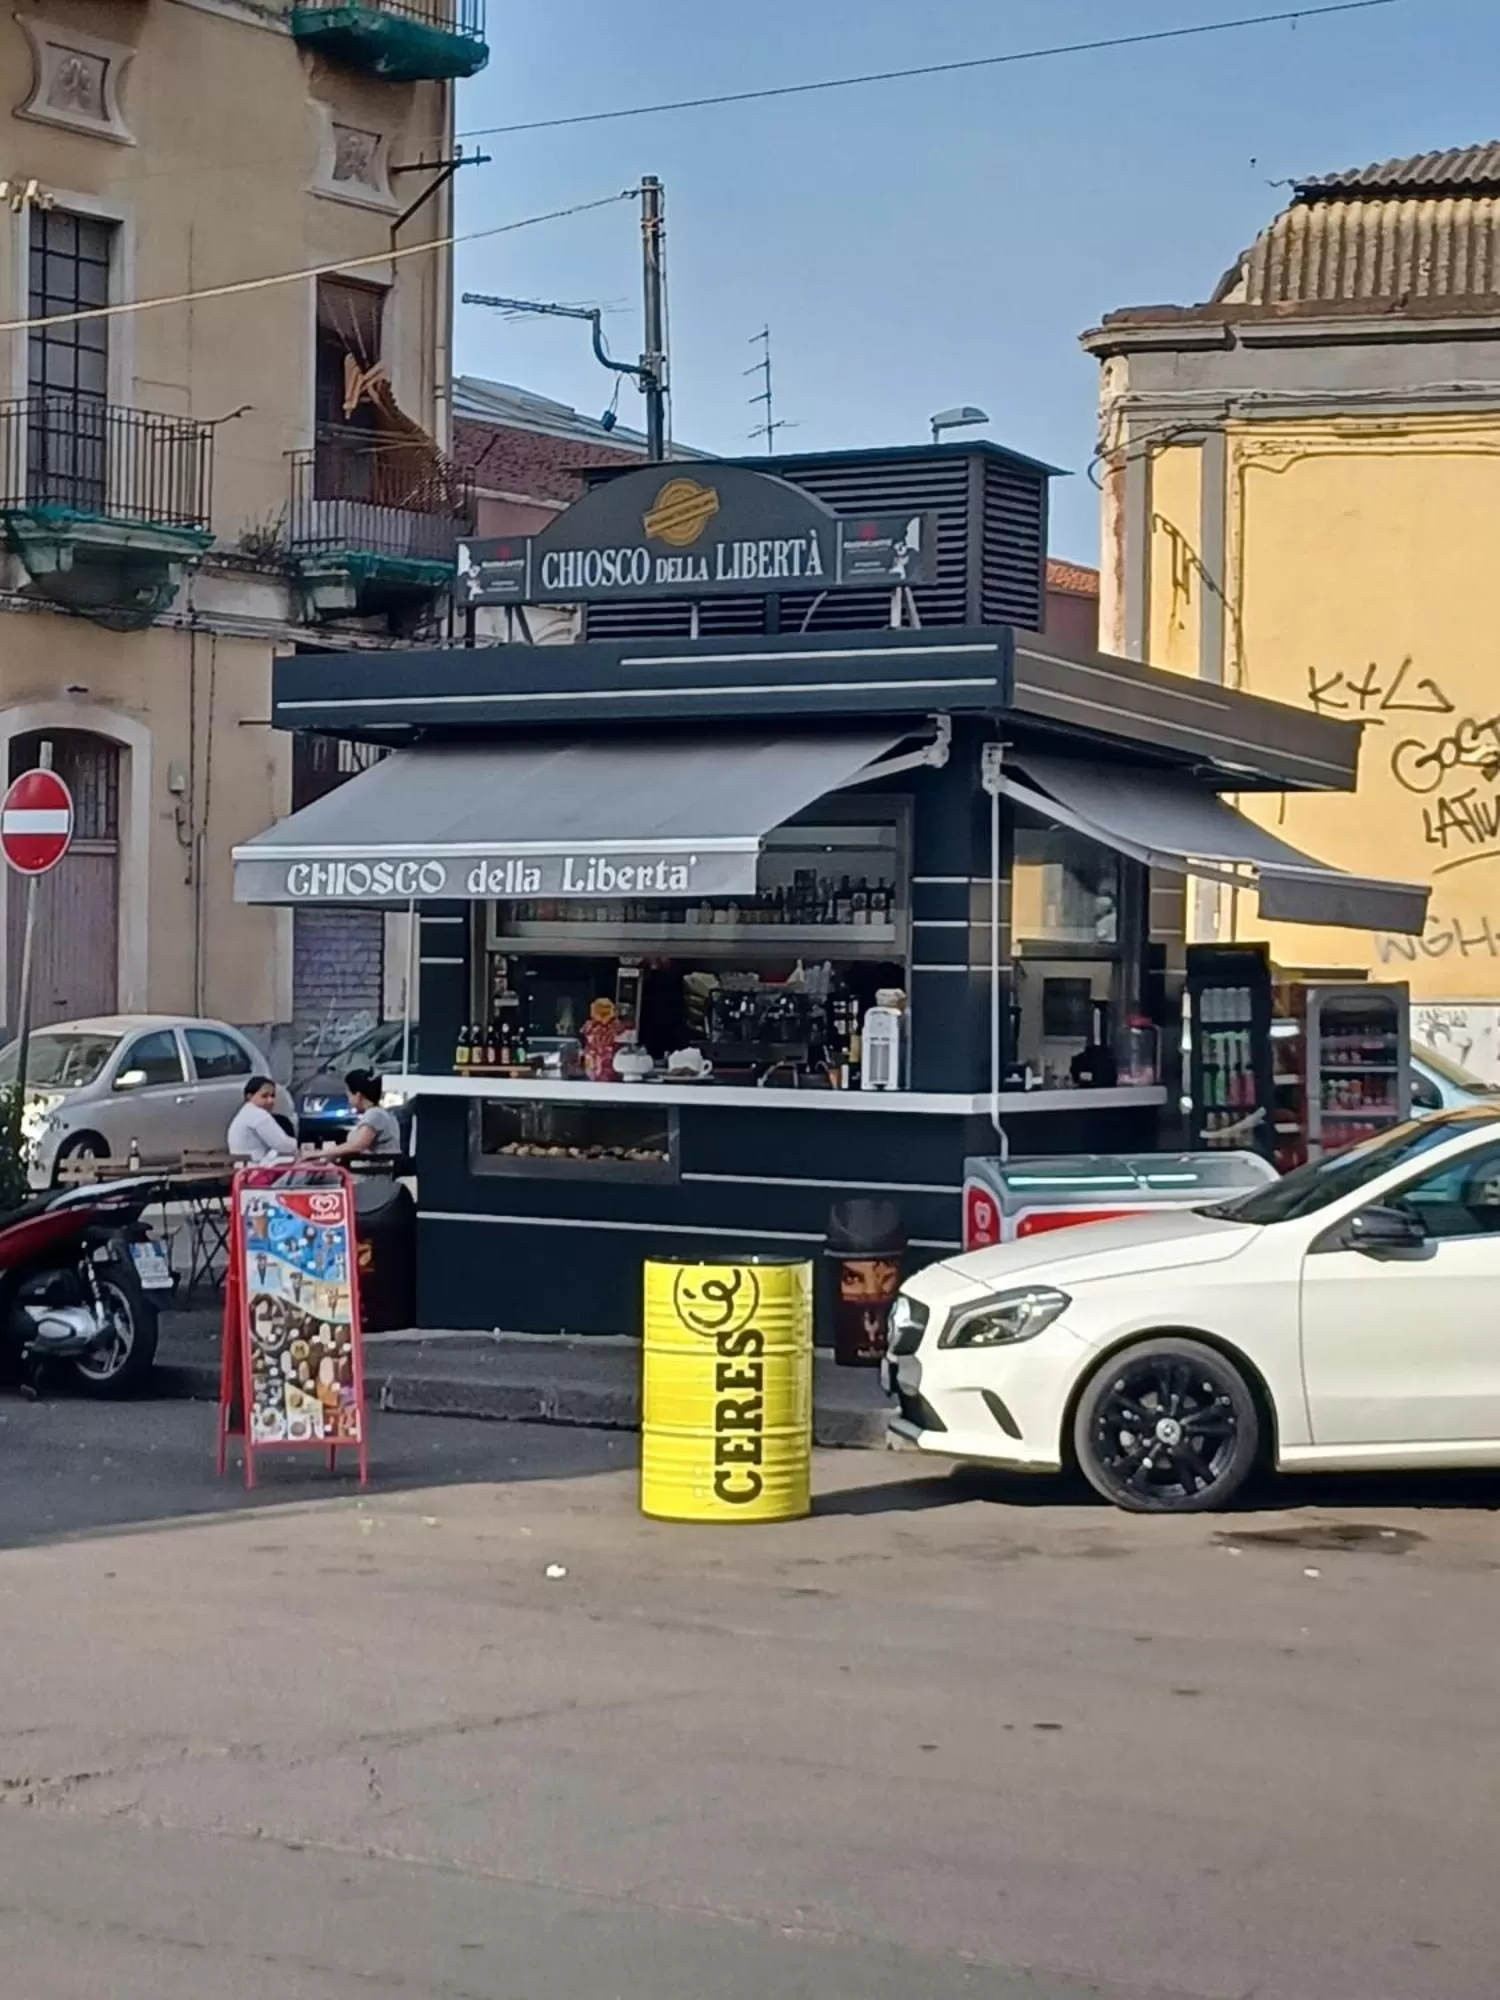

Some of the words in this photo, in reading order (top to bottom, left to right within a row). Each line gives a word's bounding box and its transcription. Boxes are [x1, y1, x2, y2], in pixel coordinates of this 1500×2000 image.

[540, 547, 650, 590] CHIOSCO
[655, 556, 709, 584] DELLA
[715, 529, 824, 581] LIBERTÀ
[287, 860, 447, 896] CHIOSCO
[467, 860, 541, 894] della
[713, 1328, 765, 1505] CERES
